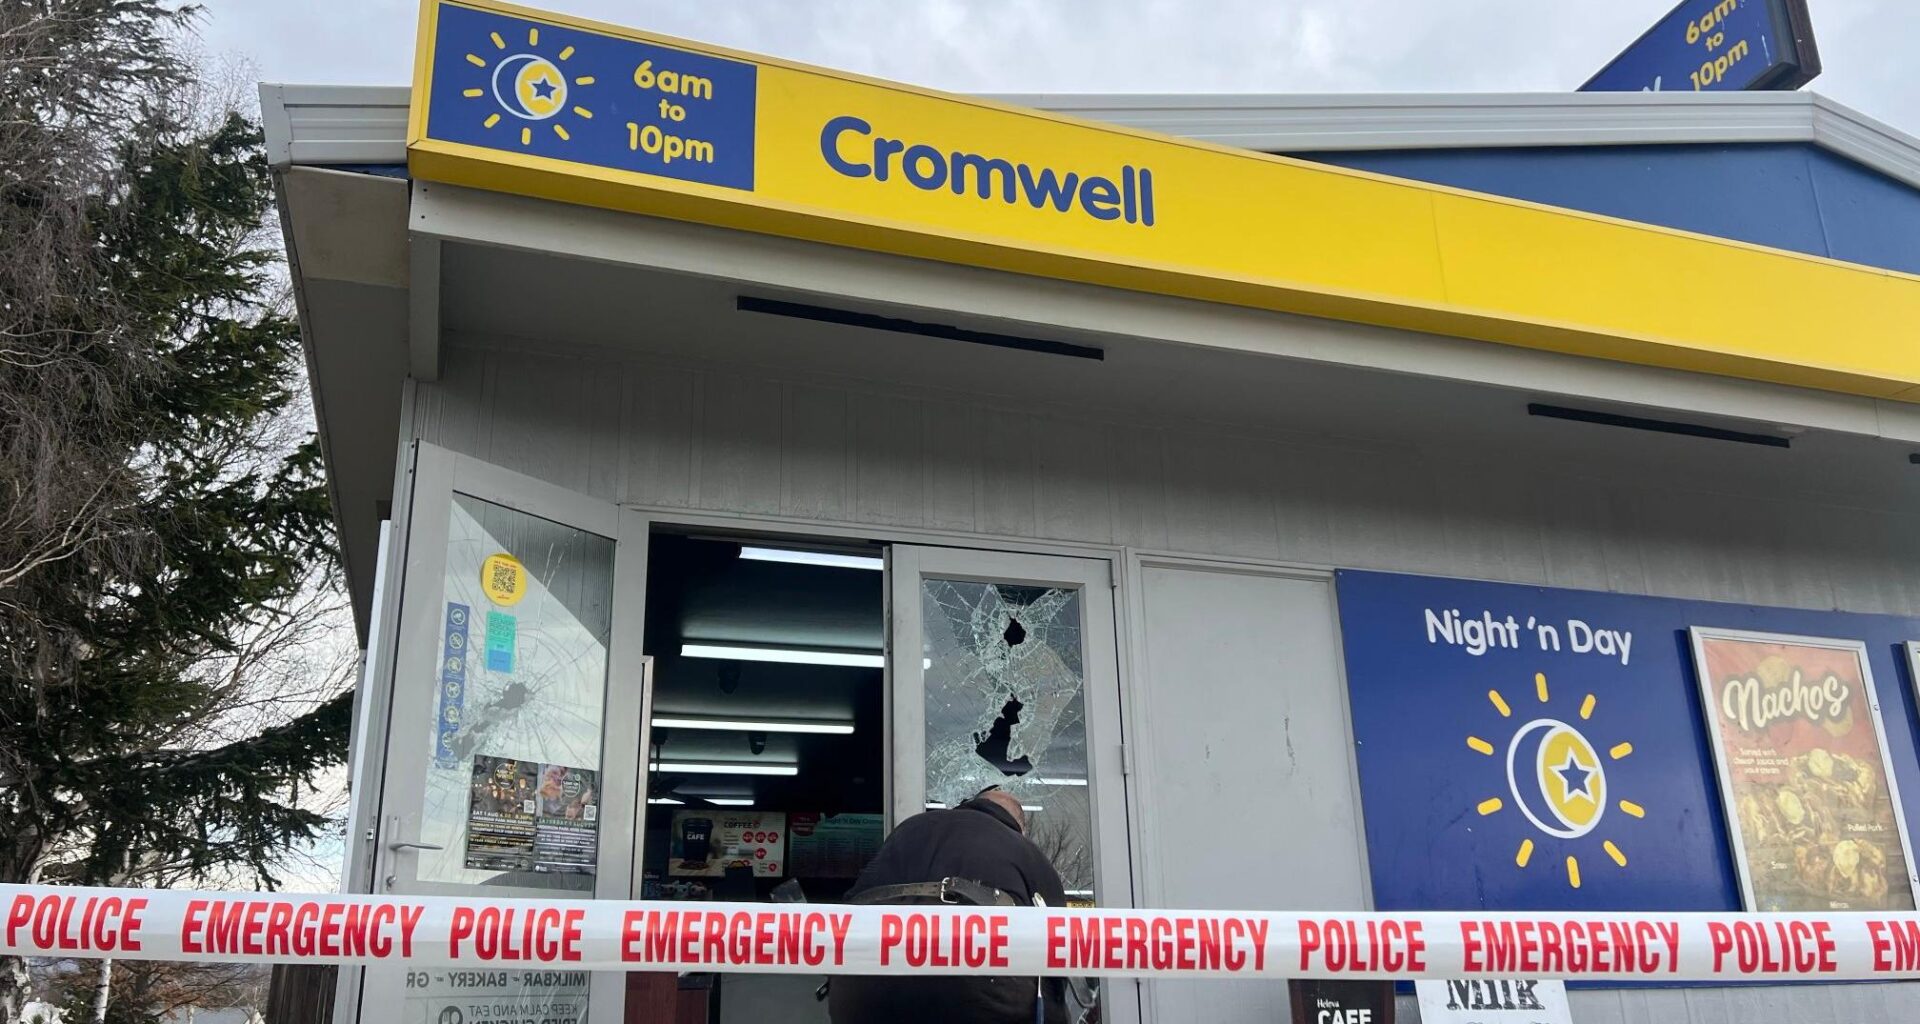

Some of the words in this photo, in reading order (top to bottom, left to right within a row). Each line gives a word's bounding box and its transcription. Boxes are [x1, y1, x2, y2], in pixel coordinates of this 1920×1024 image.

[1686, 0, 1737, 44] 6am
[1705, 32, 1724, 52] to
[633, 60, 712, 101] 6am
[1690, 39, 1748, 91] 10pm
[659, 99, 686, 122] to
[626, 123, 714, 165] 10pm
[820, 116, 1155, 227] Cromwell
[1425, 608, 1520, 656] Night
[1567, 619, 1632, 666] Day
[1723, 669, 1849, 731] Nachos
[7, 895, 147, 950] POLICE
[182, 901, 423, 957] EMERGENCY
[450, 907, 584, 961] POLICE
[622, 910, 851, 965] EMERGENCY
[880, 914, 1008, 967] POLICE
[1047, 917, 1268, 970] EMERGENCY
[1299, 920, 1425, 972] POLICE
[1460, 921, 1679, 973] EMERGENCY
[1708, 921, 1836, 972] POLICE
[1866, 920, 1920, 971] EM
[1318, 1008, 1372, 1024] CAFE
